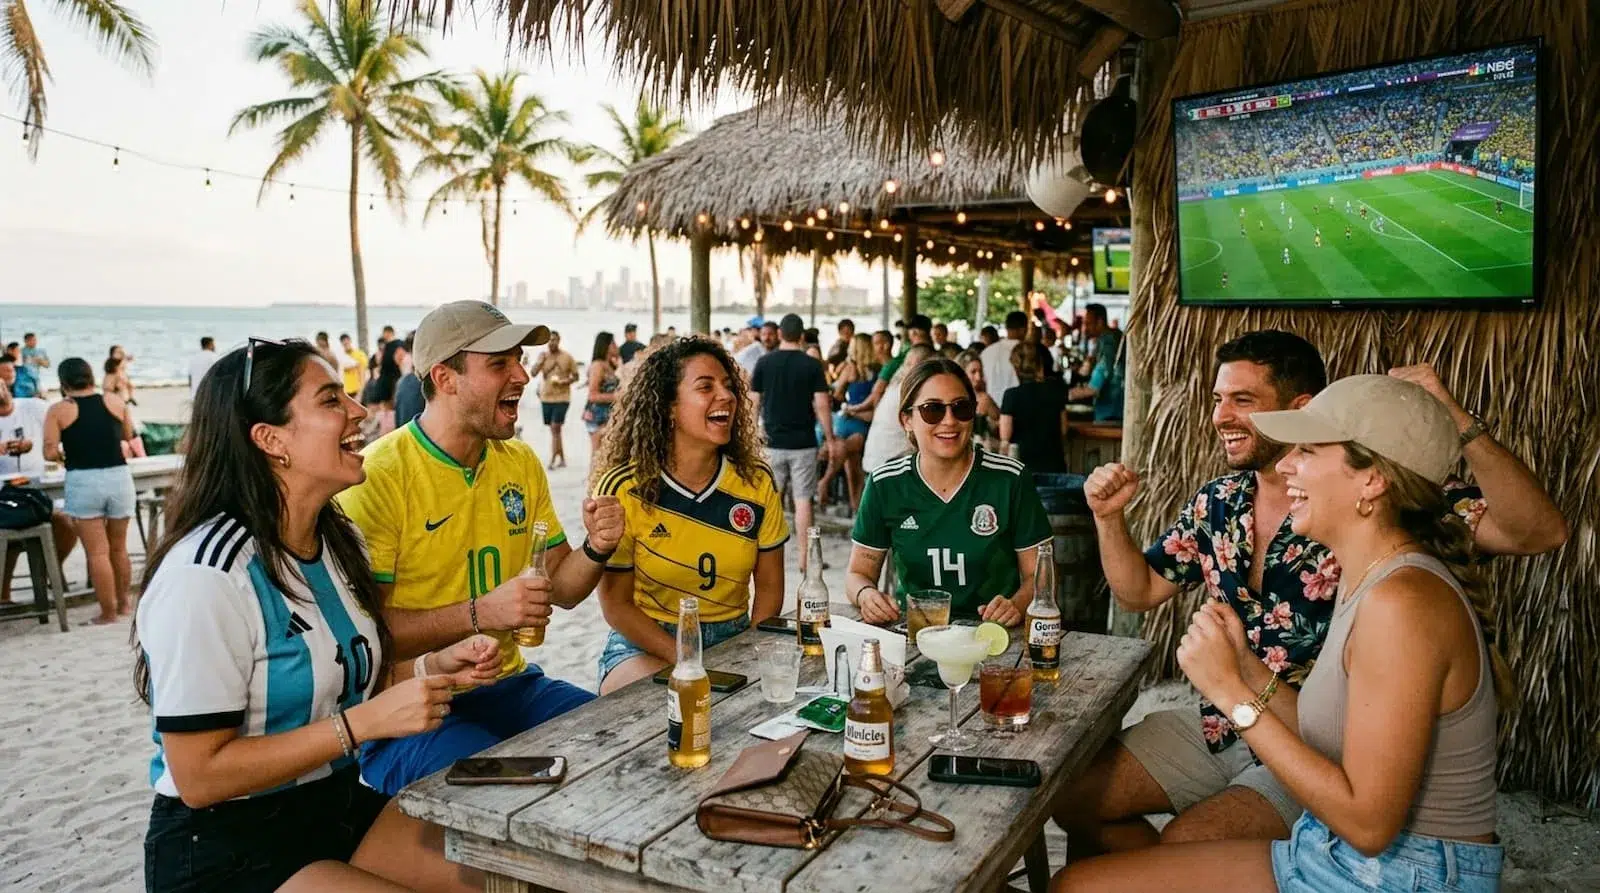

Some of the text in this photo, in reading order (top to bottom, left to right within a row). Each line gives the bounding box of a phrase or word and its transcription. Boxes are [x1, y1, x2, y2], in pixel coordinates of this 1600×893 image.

[467, 545, 503, 600] 10
[698, 552, 716, 591] 9
[926, 548, 966, 586] 14
[335, 634, 374, 704] 10
